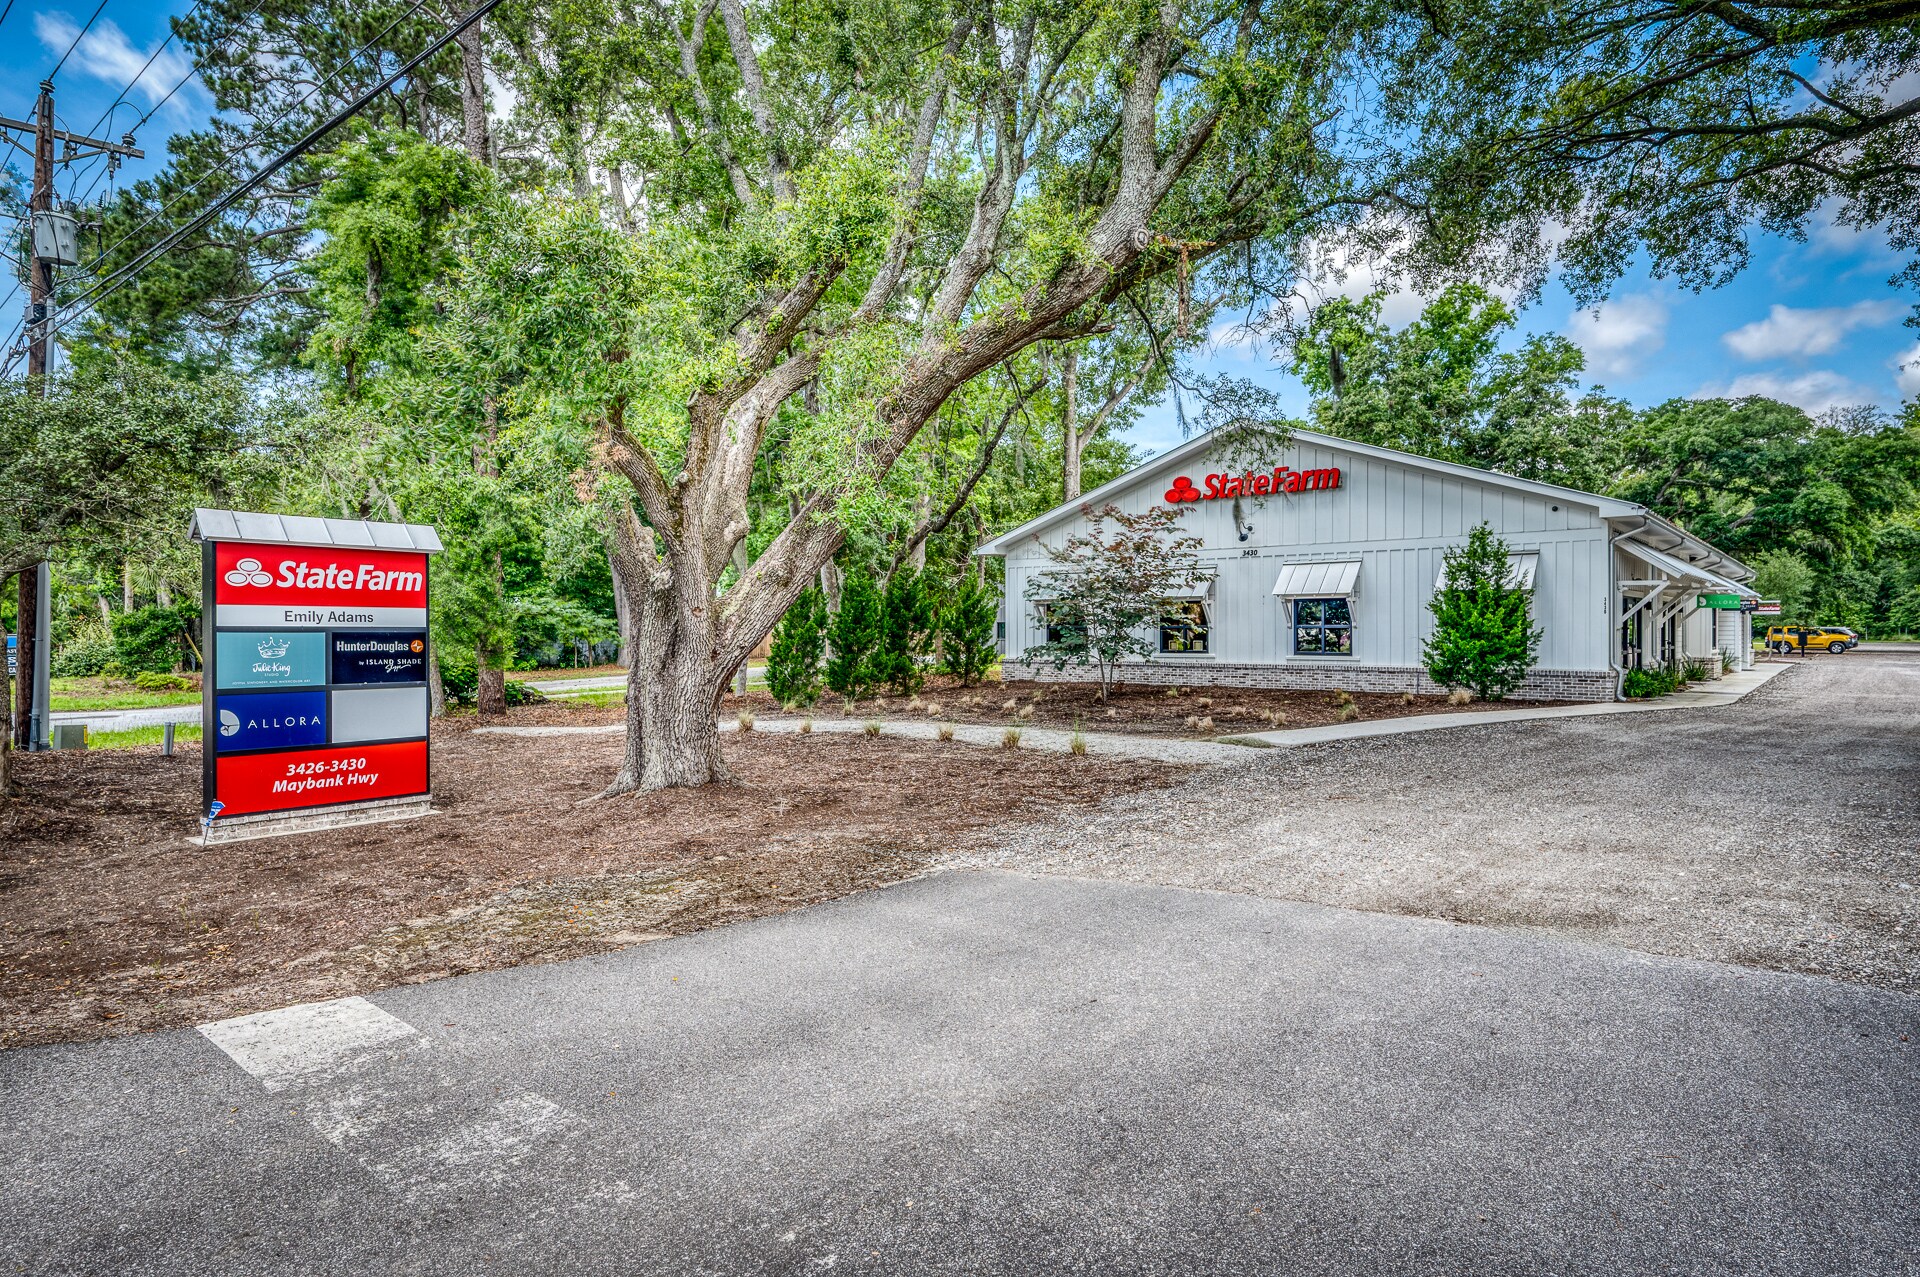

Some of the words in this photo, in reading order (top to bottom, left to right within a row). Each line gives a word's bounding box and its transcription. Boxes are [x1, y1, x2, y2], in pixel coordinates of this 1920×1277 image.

[284, 610, 324, 625] Emily
[328, 611, 374, 623] Adams
[336, 641, 409, 653] HunterDouglas
[247, 716, 321, 729] ALLORA
[286, 757, 366, 776] 3426-3430
[272, 775, 344, 794] Maybank
[347, 772, 379, 786] Hwy
